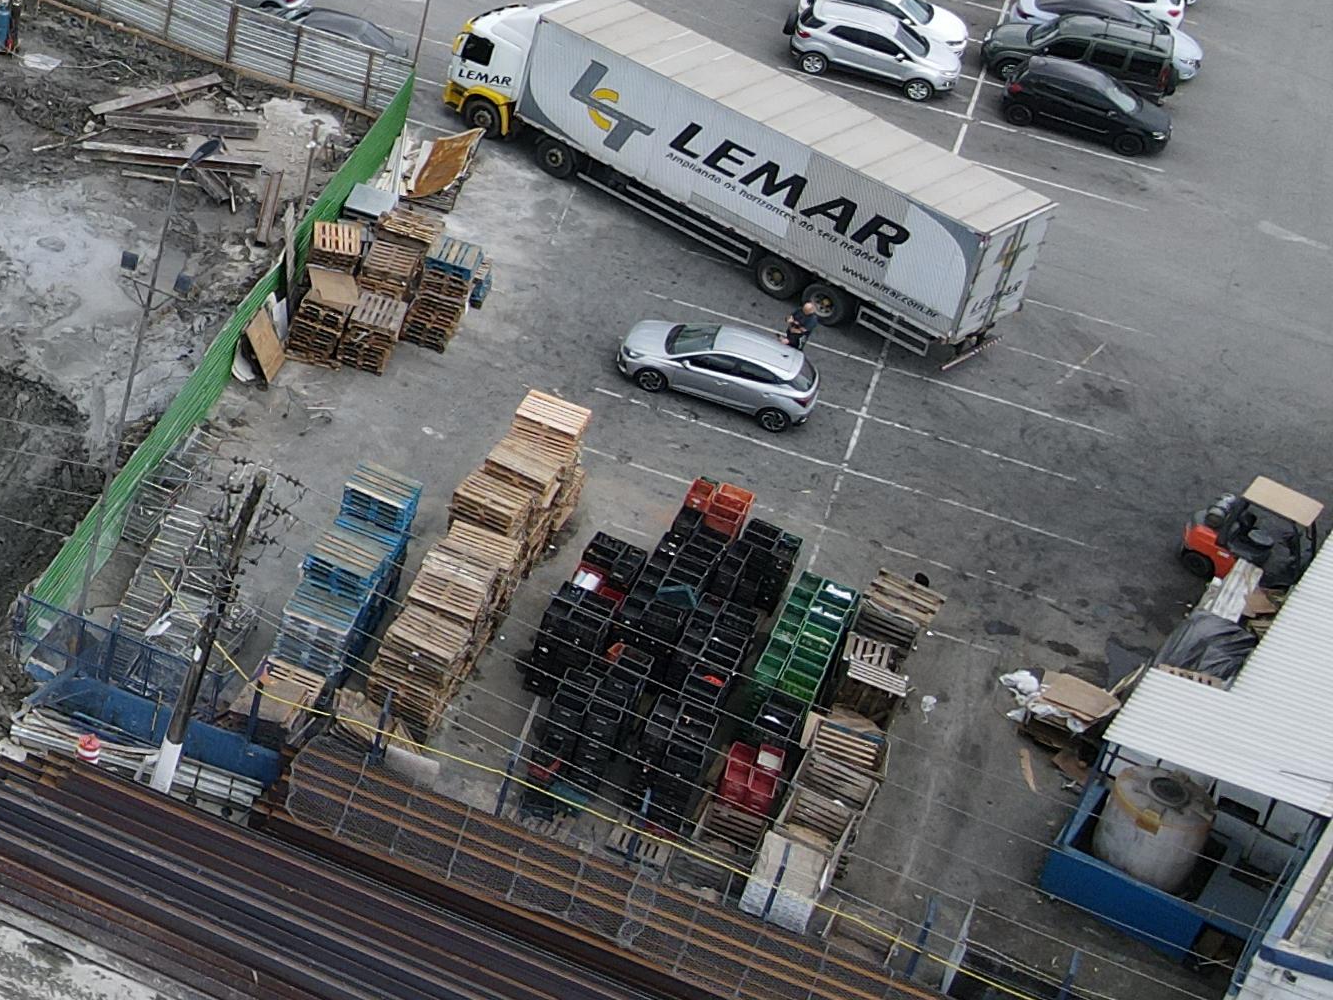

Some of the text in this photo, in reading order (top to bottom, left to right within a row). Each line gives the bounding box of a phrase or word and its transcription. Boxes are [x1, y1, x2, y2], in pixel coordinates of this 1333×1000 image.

[458, 68, 512, 86] LEMAR
[665, 152, 721, 184] Ampliando
[724, 181, 737, 192] os
[818, 228, 838, 244] seu
[669, 122, 910, 258] LEMAR
[842, 264, 942, 318] www.lemar.com.br
